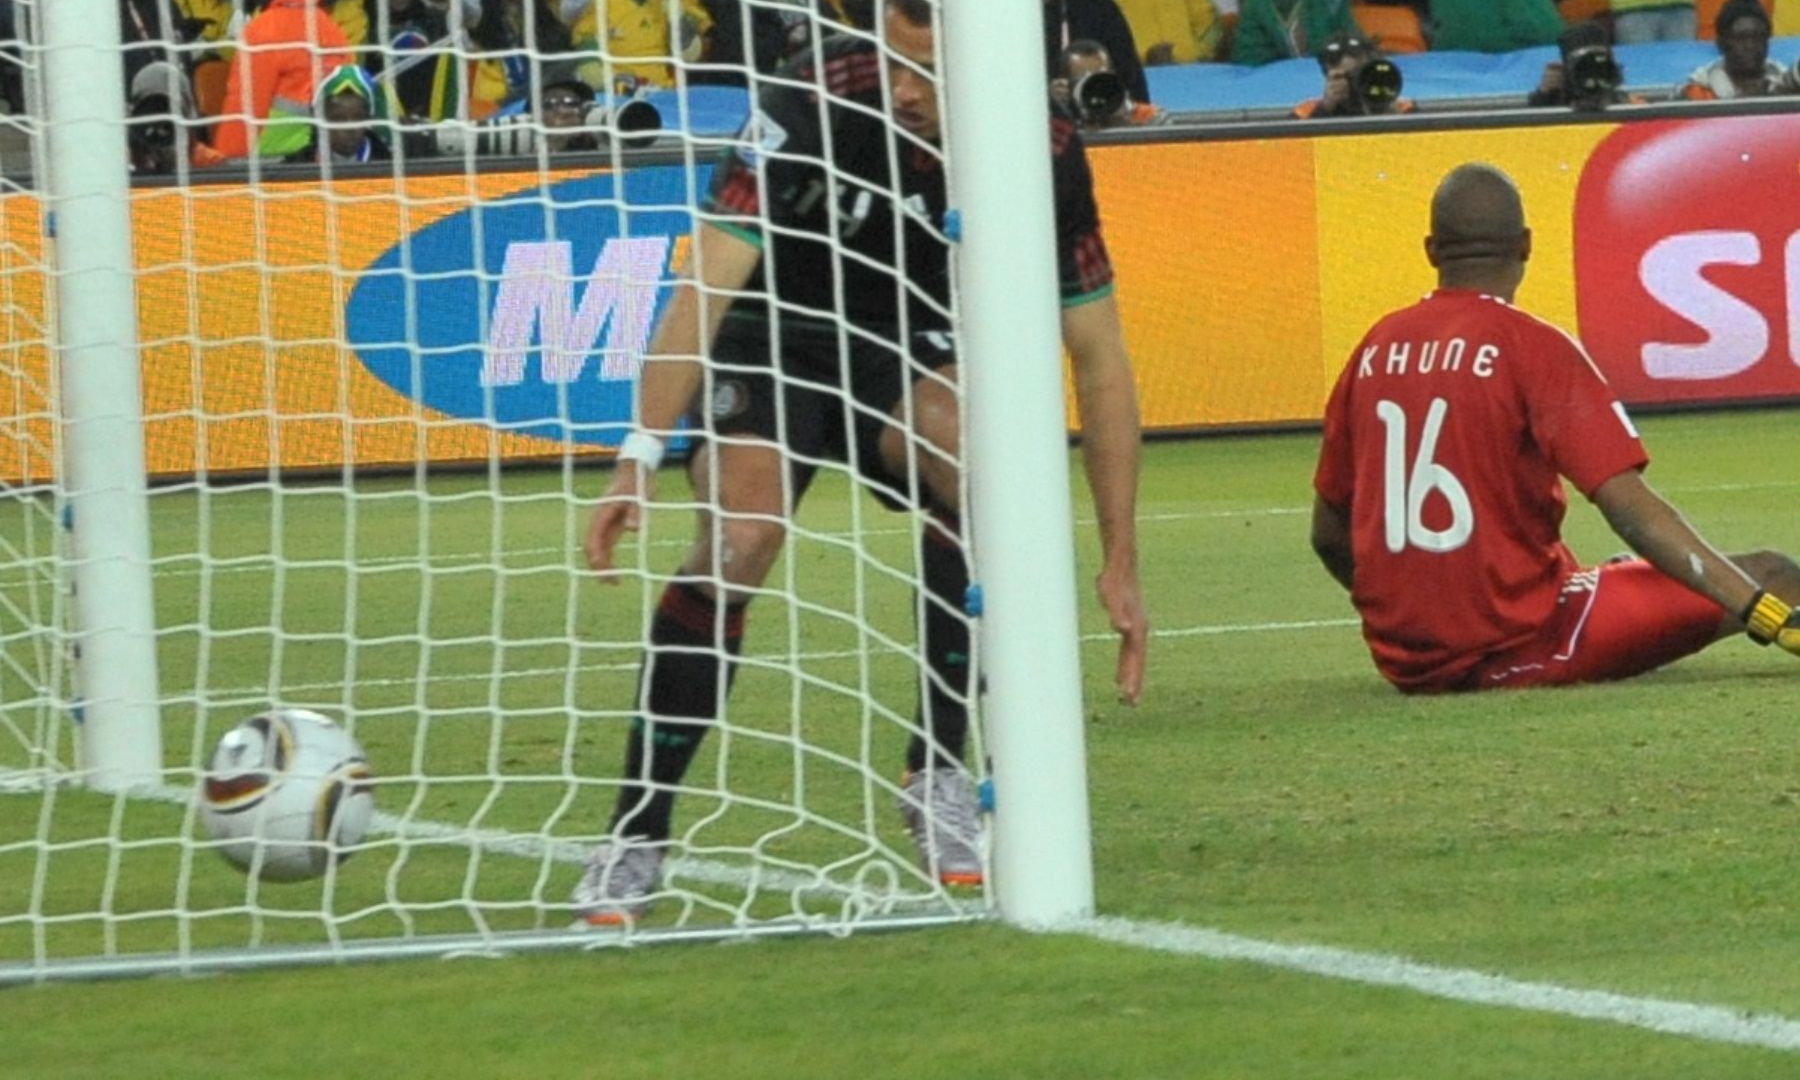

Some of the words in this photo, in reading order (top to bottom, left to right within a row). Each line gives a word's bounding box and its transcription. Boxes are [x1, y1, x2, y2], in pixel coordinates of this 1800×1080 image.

[479, 235, 692, 388] M
[1357, 337, 1500, 379] KHUNE
[1376, 397, 1475, 553] 16
